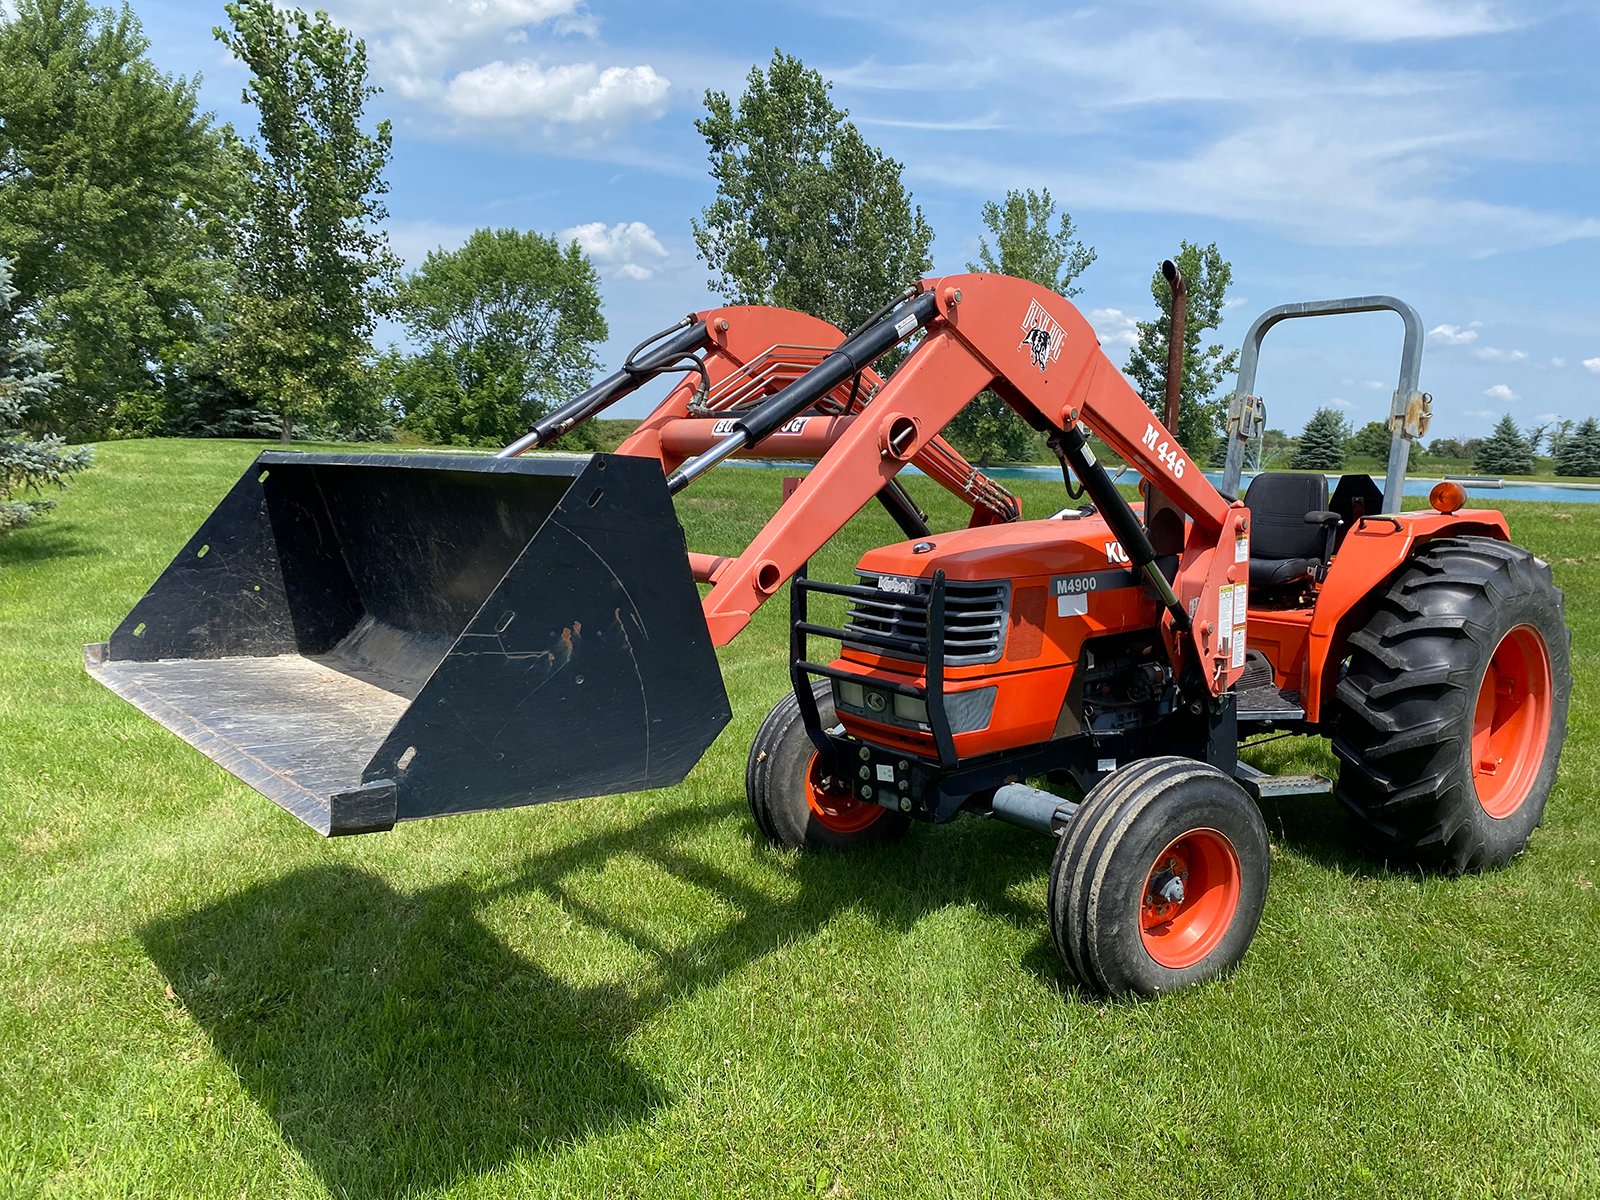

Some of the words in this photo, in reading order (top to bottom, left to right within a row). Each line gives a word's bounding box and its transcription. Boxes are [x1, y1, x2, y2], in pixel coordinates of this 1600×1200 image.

[1141, 422, 1160, 452] M
[1156, 441, 1186, 479] 446
[1056, 576, 1097, 594] M4900
